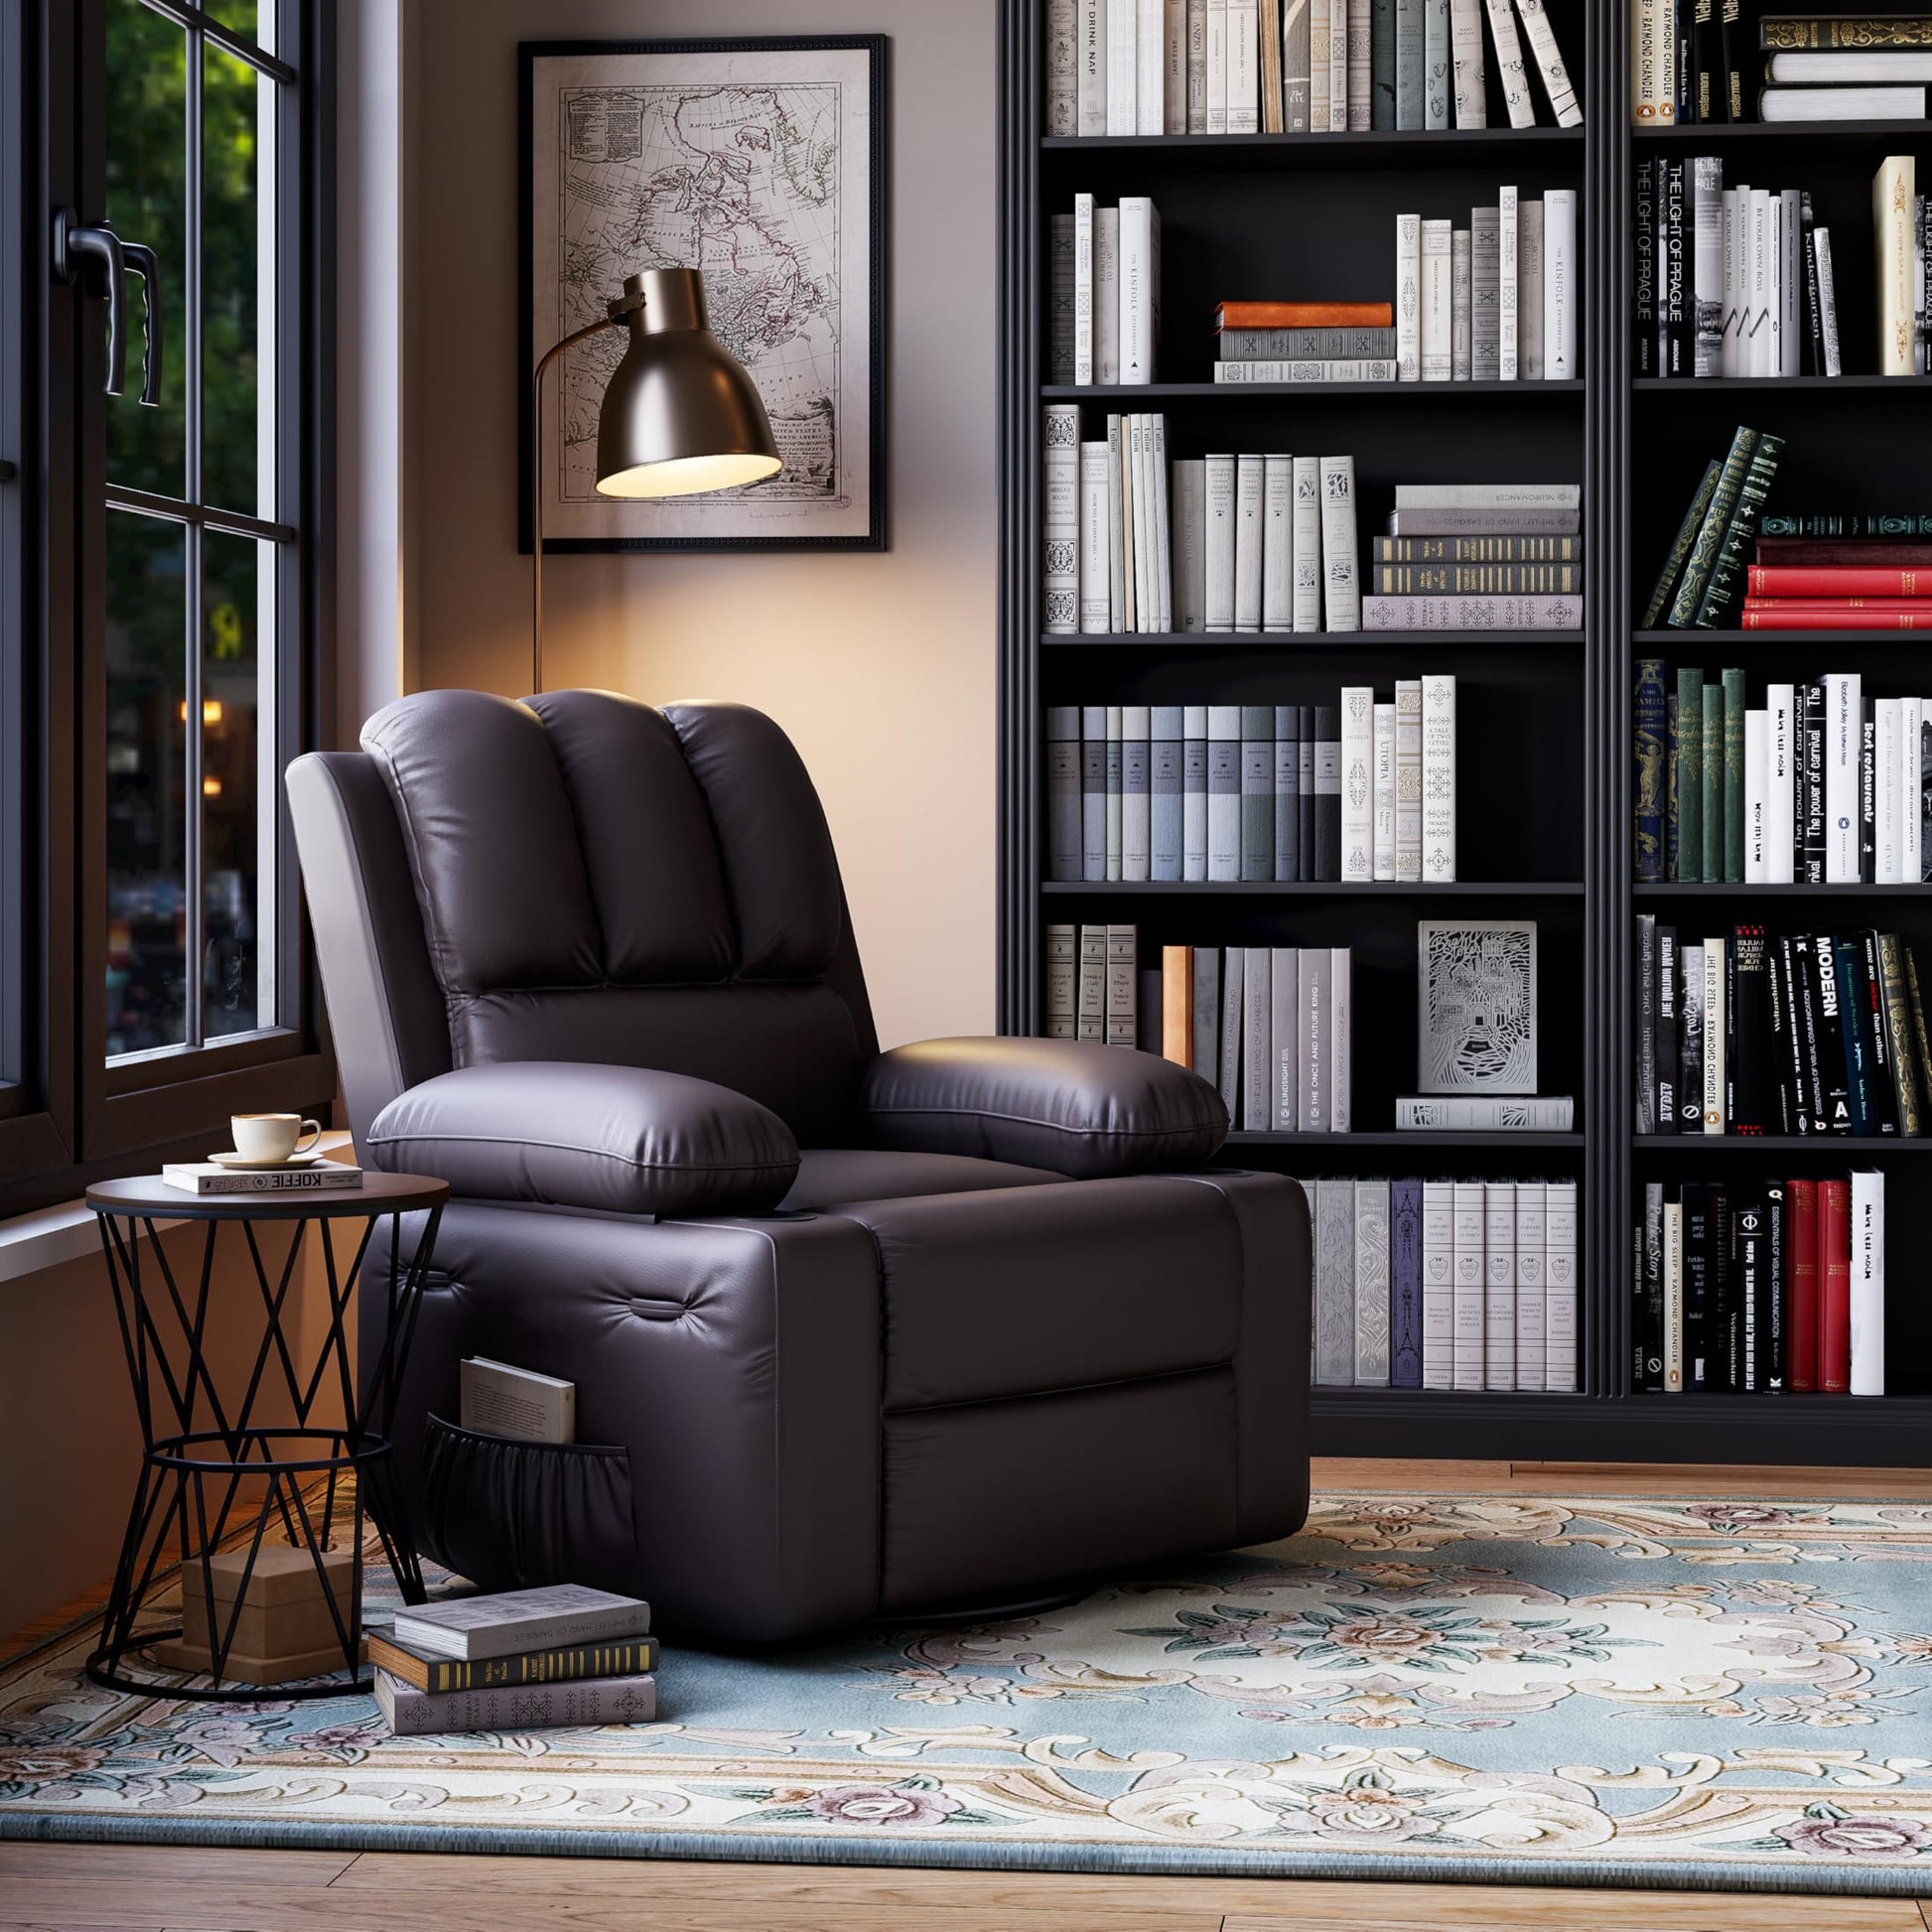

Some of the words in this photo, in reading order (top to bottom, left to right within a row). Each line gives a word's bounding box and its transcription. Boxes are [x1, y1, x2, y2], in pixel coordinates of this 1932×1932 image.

[1088, 11, 1097, 47] DRINK
[1192, 22, 1201, 51] ANZIO
[1641, 18, 1652, 57] RAYMOND
[1663, 8, 1672, 50] RAYMOND
[1088, 52, 1097, 75] NAP
[1663, 53, 1672, 96] CHANDLER
[1641, 59, 1652, 99] CHANDLER
[1699, 72, 1710, 118] westermann
[1729, 71, 1741, 117] westermann
[1637, 160, 1651, 190] THE
[1669, 165, 1682, 194] THE
[1637, 192, 1651, 234] LIGHT
[1669, 196, 1682, 237] LIGHT
[1725, 208, 1732, 217] BE
[1740, 204, 1746, 213] BE
[1756, 207, 1763, 217] BE
[1637, 236, 1651, 257] OF
[1669, 239, 1682, 260] OF
[1637, 259, 1651, 320] PRAGUE
[1669, 262, 1682, 322] PRAGUE
[1805, 232, 1821, 339] Kindergarten
[1806, 687, 1821, 707] The
[1840, 681, 1849, 707] Elizabeth
[1777, 709, 1786, 731] Make
[1840, 708, 1849, 724] Jolley
[1777, 735, 1786, 751] less
[1806, 729, 1821, 768] carnival
[1863, 723, 1874, 750] Best
[1379, 742, 1389, 780] UTOPIA
[1777, 755, 1786, 777] noise
[1795, 755, 1803, 771] of
[1806, 770, 1821, 782] of
[1863, 753, 1874, 823] restaurants
[1806, 785, 1823, 815] power
[1806, 818, 1821, 838] The
[1796, 941, 1807, 952] K
[1816, 936, 1838, 1017] MODERN
[1846, 963, 1856, 998] Dreaming
[1769, 957, 1781, 1033] Weltarchitektur
[1803, 989, 1816, 1043] COMMUNICATION
[1869, 982, 1878, 1012] sicker
[1875, 1035, 1884, 1064] others
[1254, 1036, 1261, 1046] OF
[1812, 1066, 1820, 1075] OF
[1813, 1077, 1823, 1115] ESSENTIALS
[1835, 1101, 1849, 1118] A
[271, 1173, 322, 1188] KOFFIE
[1646, 1204, 1661, 1245] Perfect
[1771, 1206, 1780, 1245] ESSENTIALS
[1863, 1204, 1872, 1228] Make
[1771, 1246, 1780, 1257] OF
[1863, 1232, 1872, 1250] less
[1646, 1248, 1663, 1280] Story
[1771, 1257, 1780, 1280] VISUAL
[1863, 1255, 1872, 1280] noise
[1771, 1281, 1780, 1338] COMMUNICATION
[1769, 1378, 1781, 1388] K
